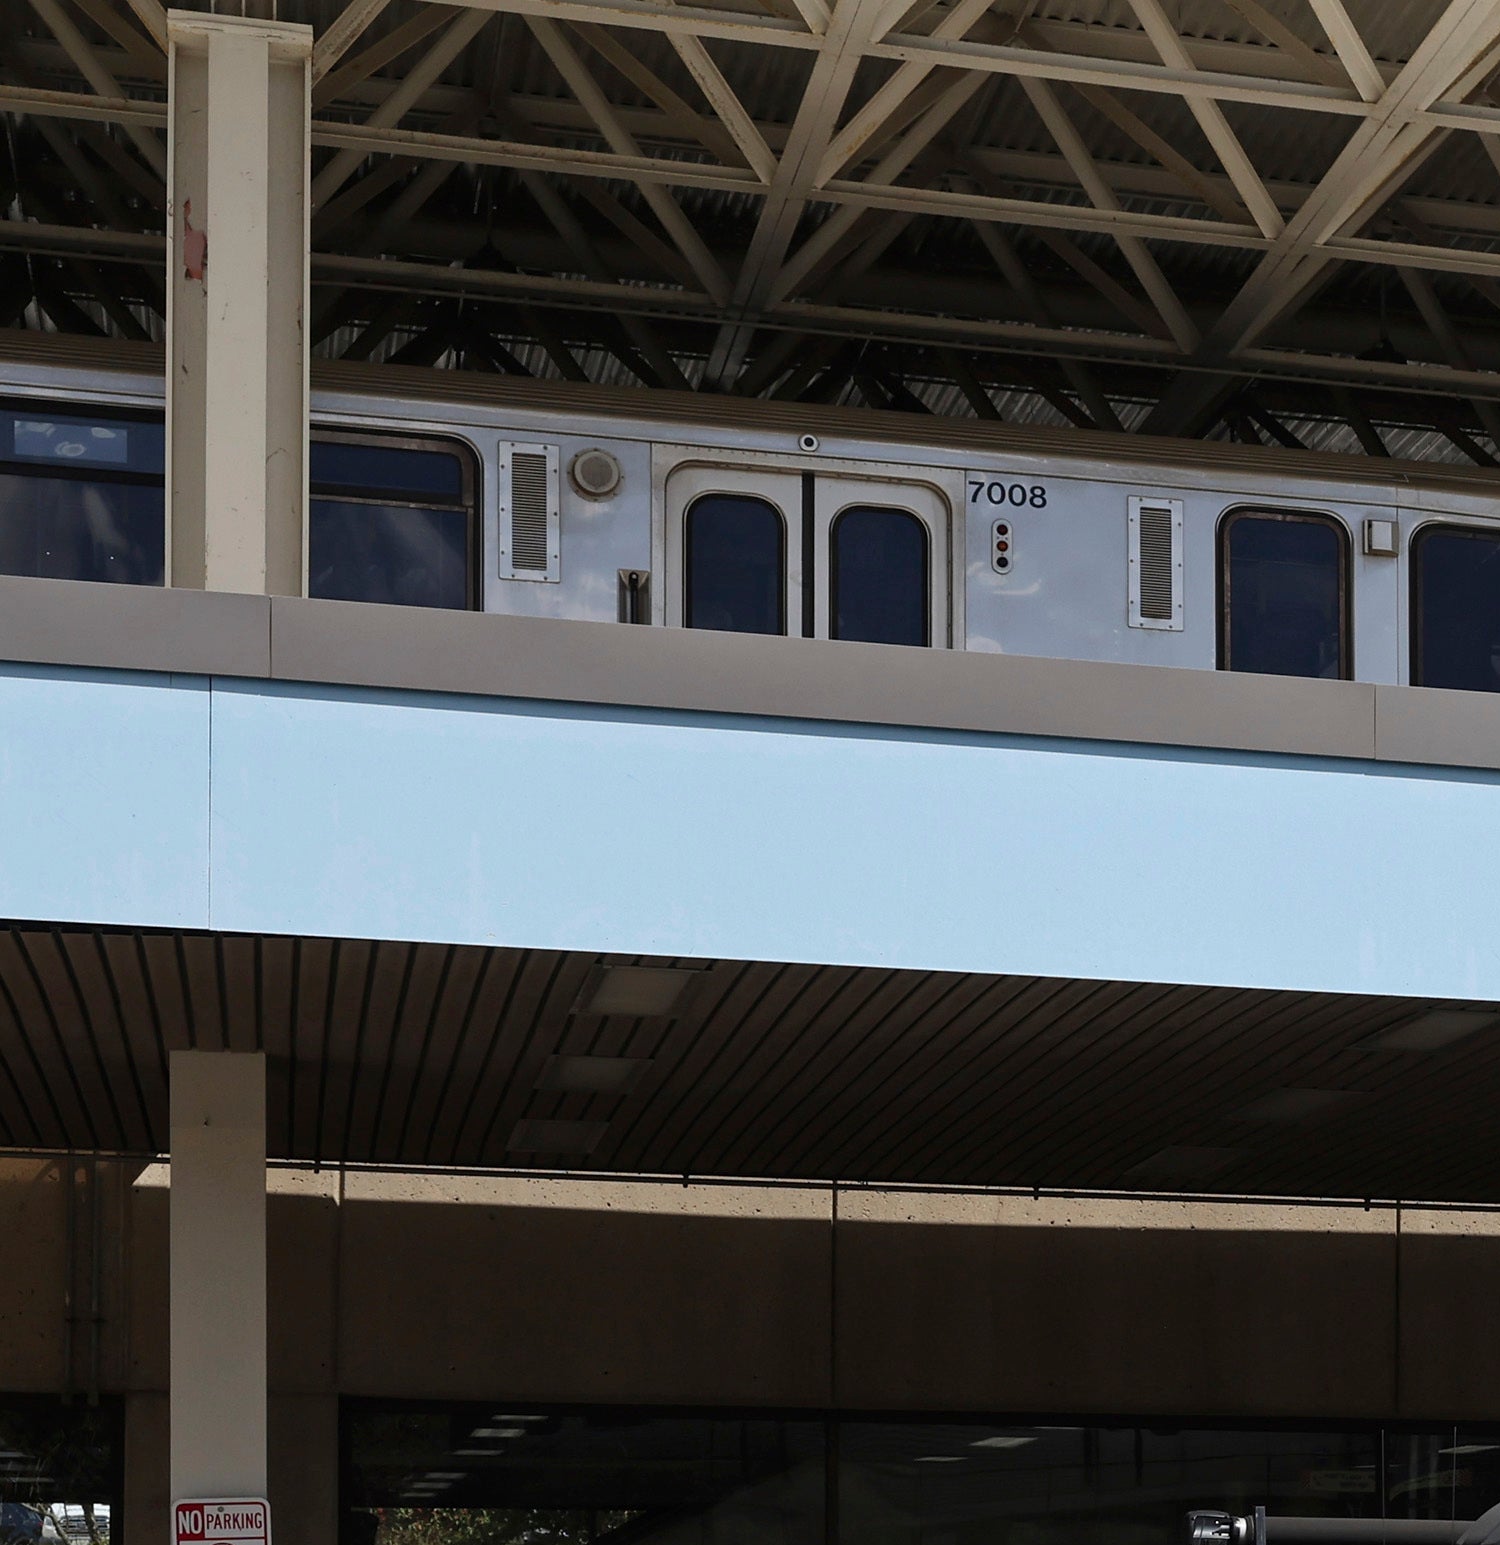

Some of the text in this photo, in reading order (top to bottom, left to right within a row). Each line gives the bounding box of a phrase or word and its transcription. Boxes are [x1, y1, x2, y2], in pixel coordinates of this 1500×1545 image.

[967, 479, 1048, 509] 7008
[178, 1510, 262, 1535] NO PARKING
